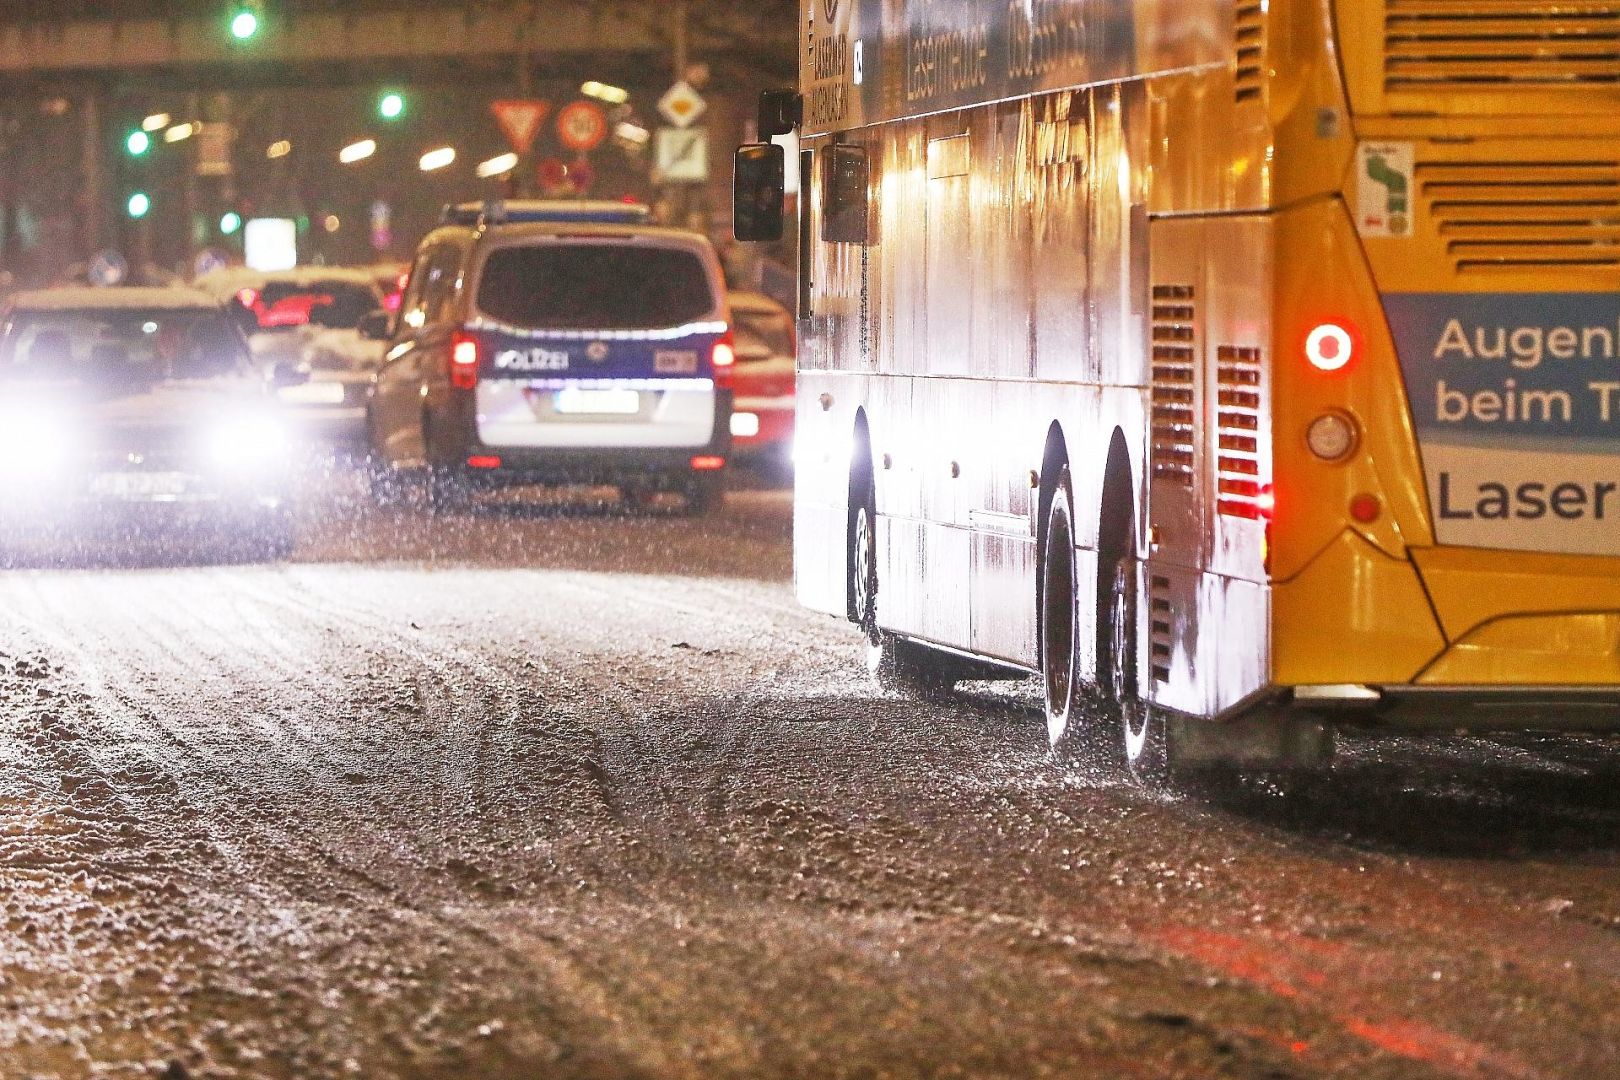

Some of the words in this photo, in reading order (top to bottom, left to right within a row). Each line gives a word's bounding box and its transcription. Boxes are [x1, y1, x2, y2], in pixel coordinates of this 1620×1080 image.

[814, 33, 847, 81] LASERMED
[494, 348, 570, 371] OLIZEI
[1434, 315, 1620, 369] Augen
[1434, 379, 1573, 424] beim
[1587, 381, 1620, 424] T
[1438, 471, 1617, 521] Laser
